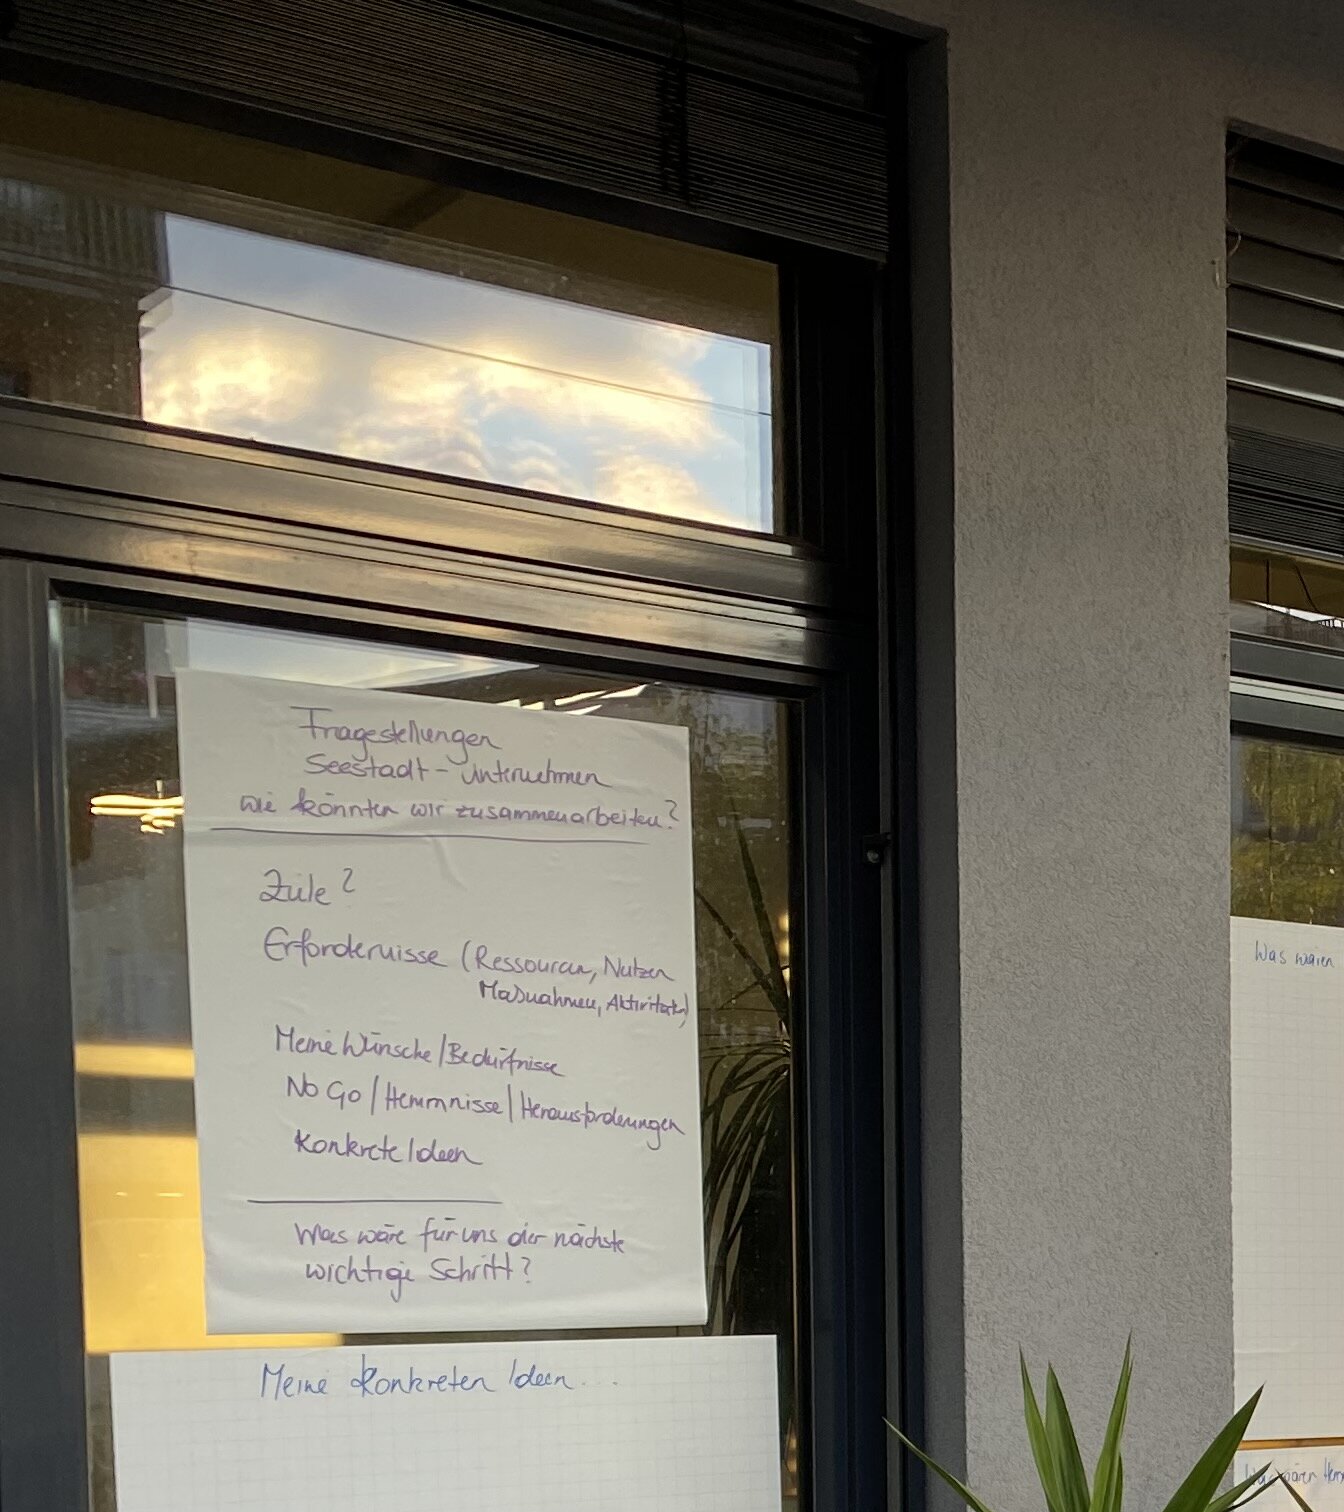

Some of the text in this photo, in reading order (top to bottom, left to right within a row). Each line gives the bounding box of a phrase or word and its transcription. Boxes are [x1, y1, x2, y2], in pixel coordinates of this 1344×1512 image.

[290, 706, 502, 765] Fragestellungen
[410, 803, 446, 819] wir
[263, 926, 449, 968] Erfordernisse
[604, 955, 676, 982] Nutzen
[1255, 940, 1288, 964] Was
[275, 1024, 334, 1055] Meine
[293, 1221, 347, 1247] Was
[357, 1223, 406, 1247] wäre
[419, 1216, 458, 1253] für
[461, 1229, 498, 1247] uns
[261, 1362, 329, 1401] Meine
